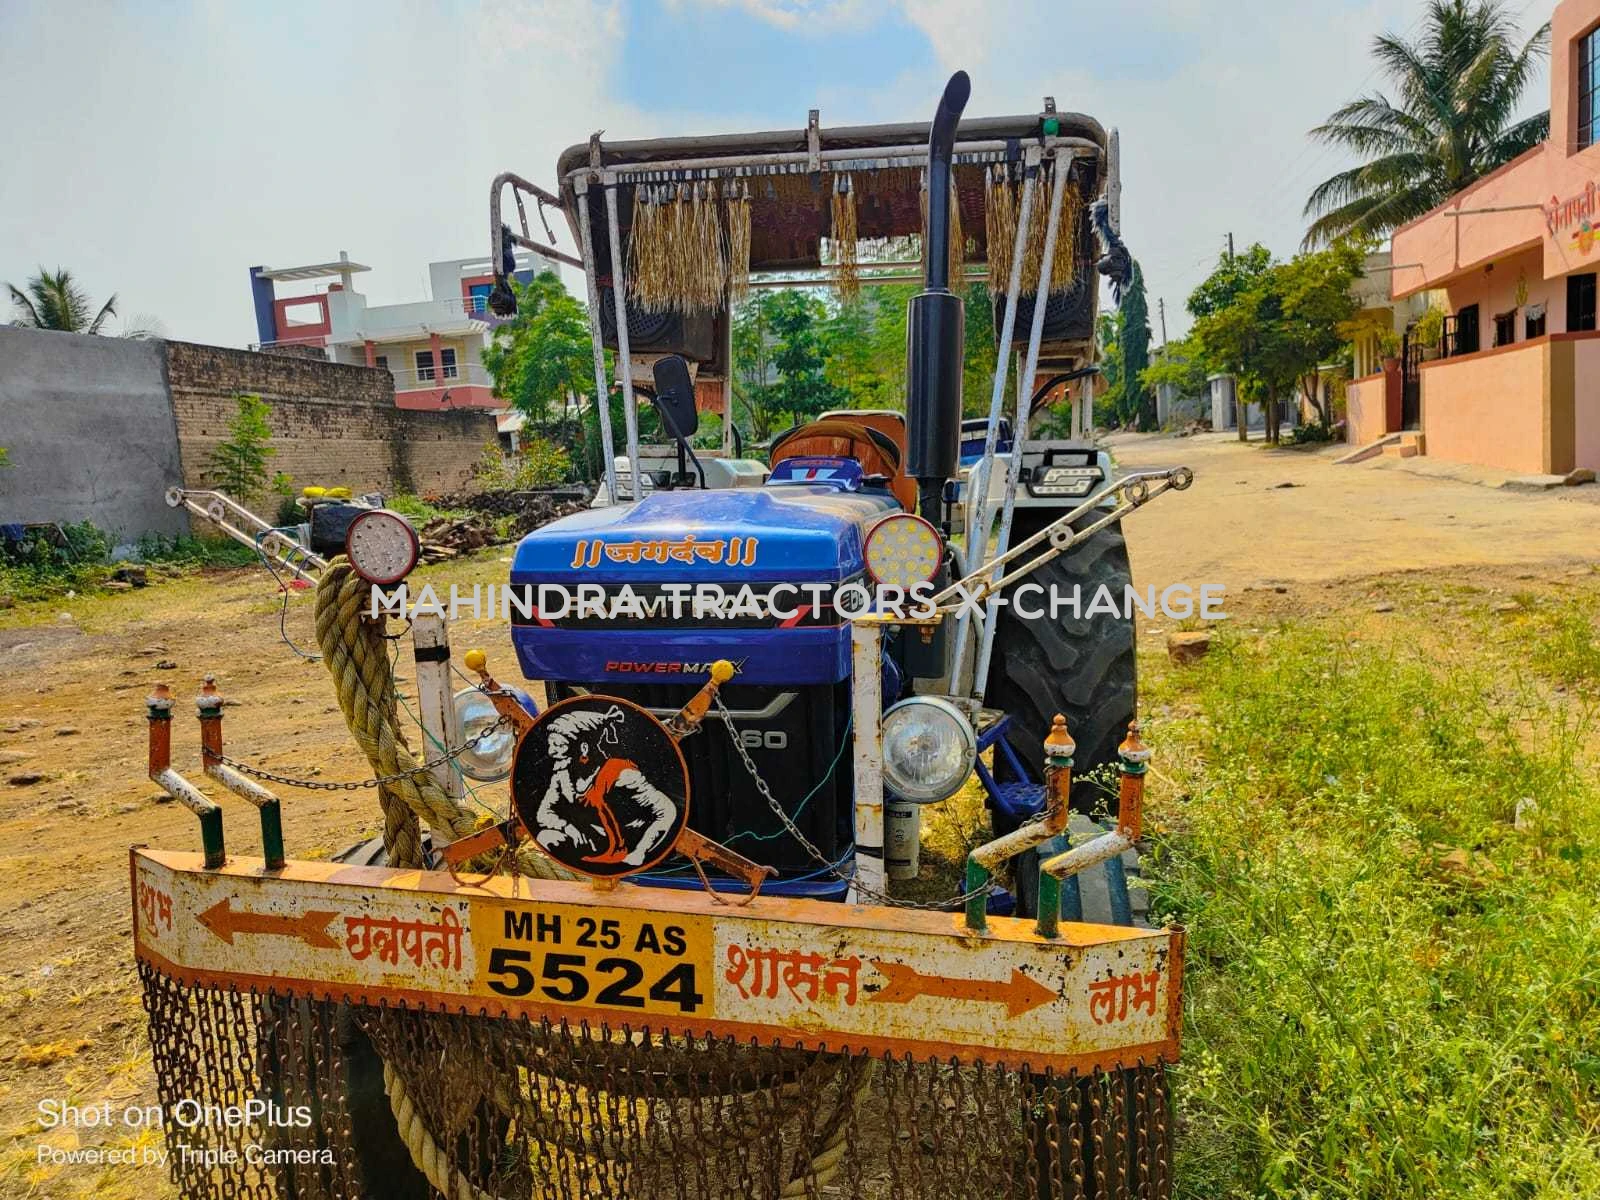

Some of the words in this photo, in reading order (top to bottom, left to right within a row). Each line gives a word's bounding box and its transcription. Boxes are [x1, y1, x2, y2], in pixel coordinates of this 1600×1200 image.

[740, 729, 787, 749] 60
[140, 880, 173, 938] शुभ
[504, 910, 562, 944] MH
[576, 917, 621, 950] 25
[634, 923, 687, 956] AS
[487, 947, 704, 1013] 5524
[725, 944, 862, 1007] शासन
[1088, 969, 1161, 1026] लाभ
